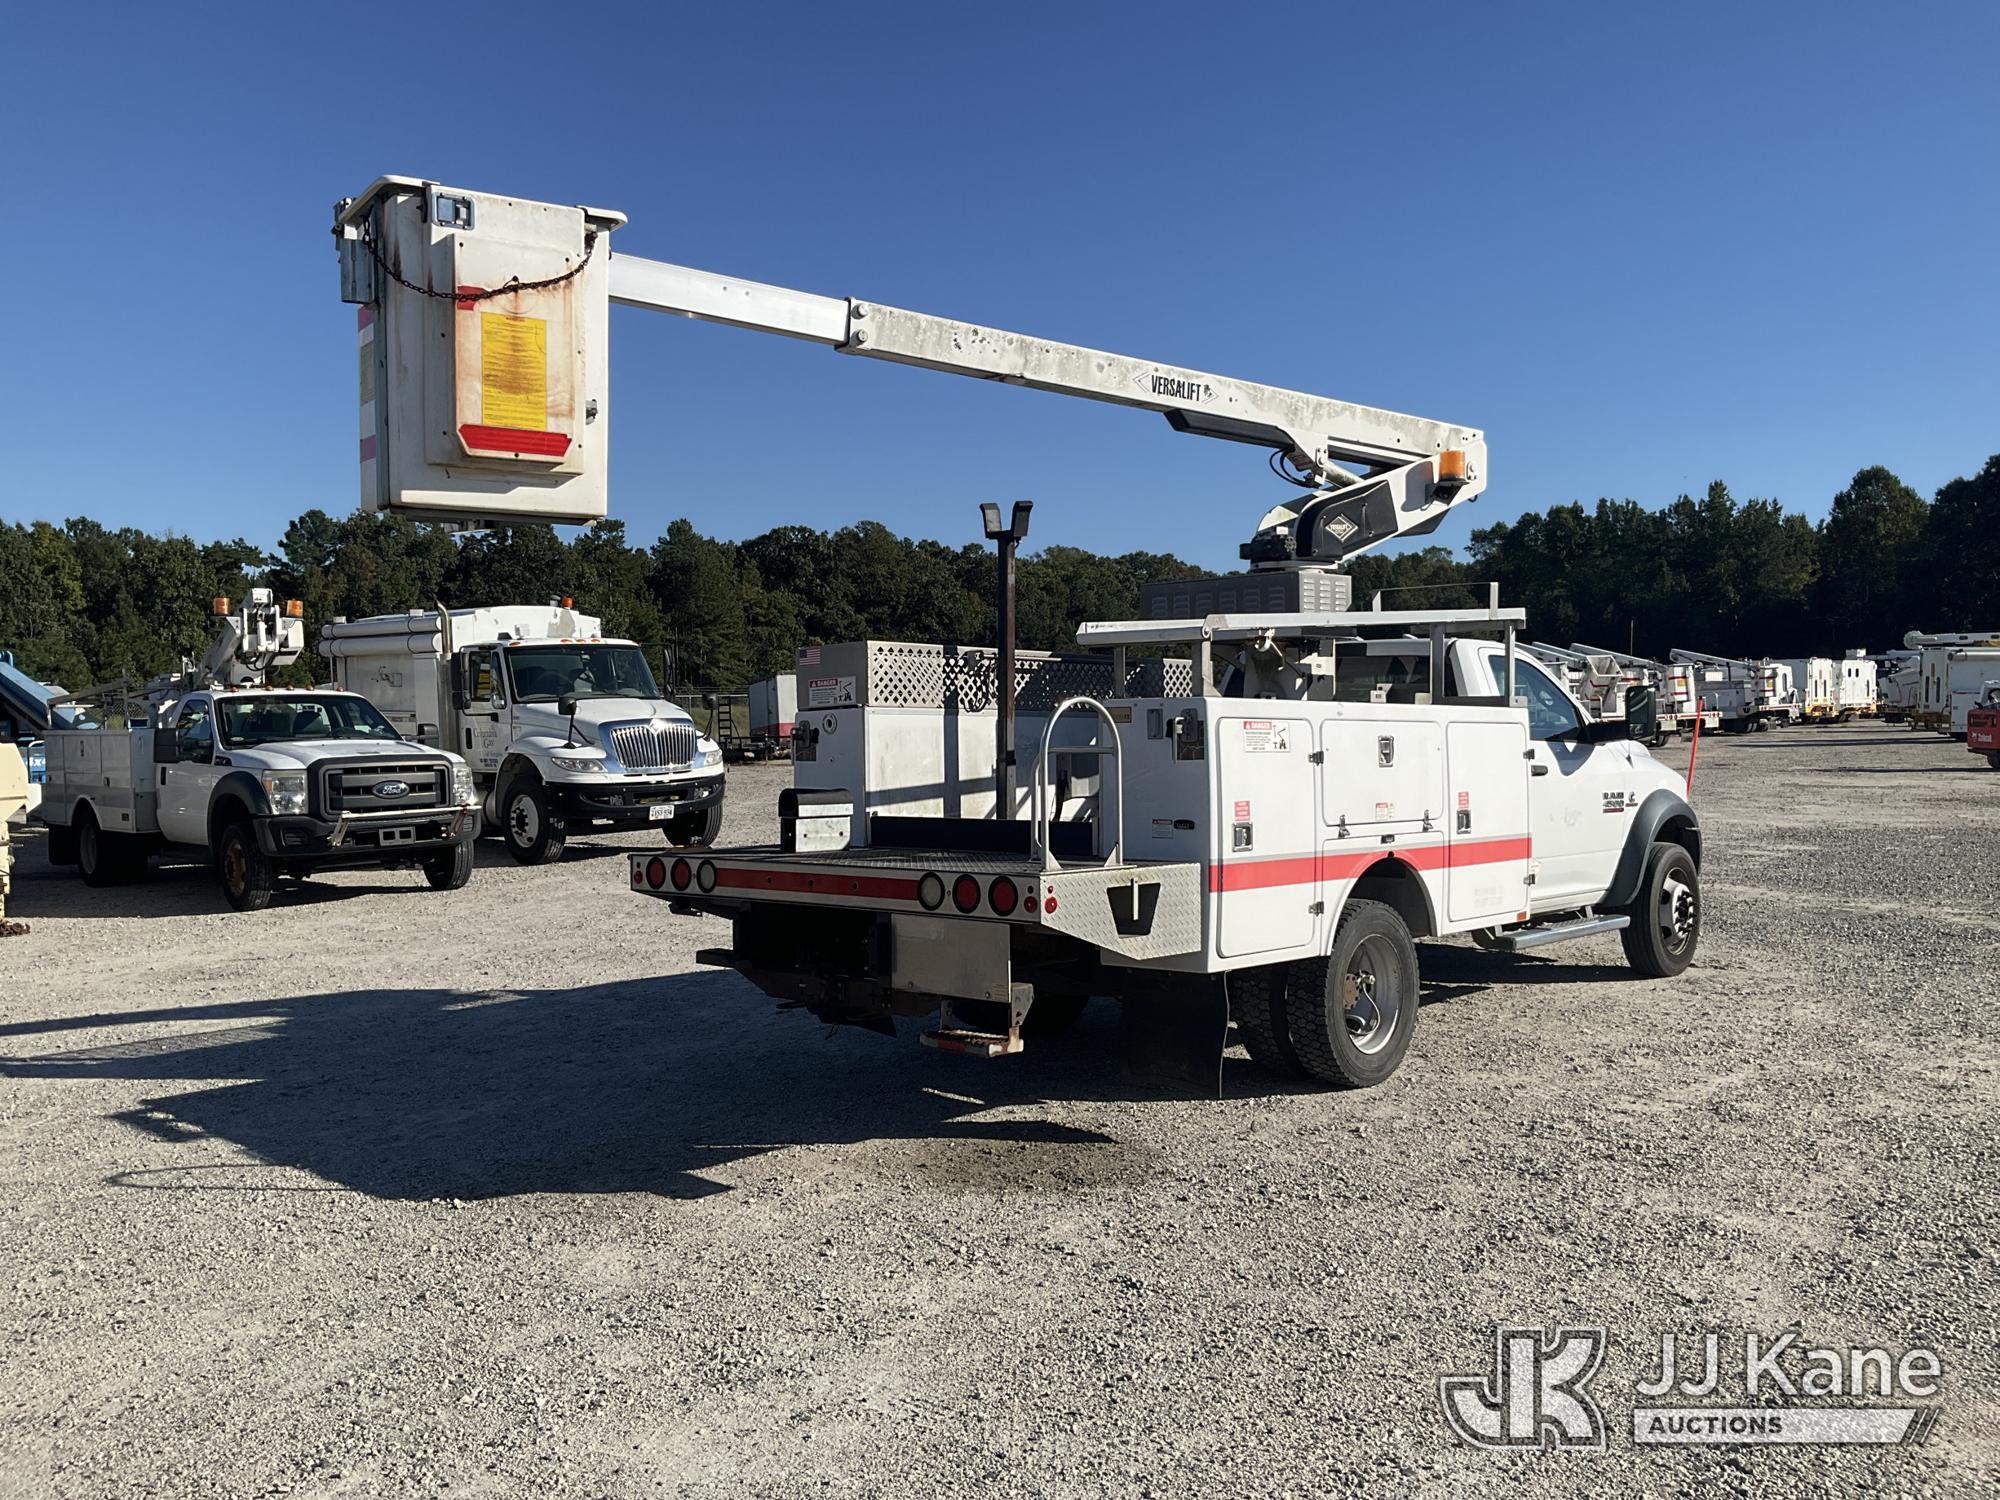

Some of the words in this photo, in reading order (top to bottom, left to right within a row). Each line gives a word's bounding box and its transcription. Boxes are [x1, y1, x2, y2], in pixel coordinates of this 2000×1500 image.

[1151, 374, 1201, 402] VERSALIFT
[382, 784, 403, 795] Ford
[1602, 792, 1624, 800] RAM
